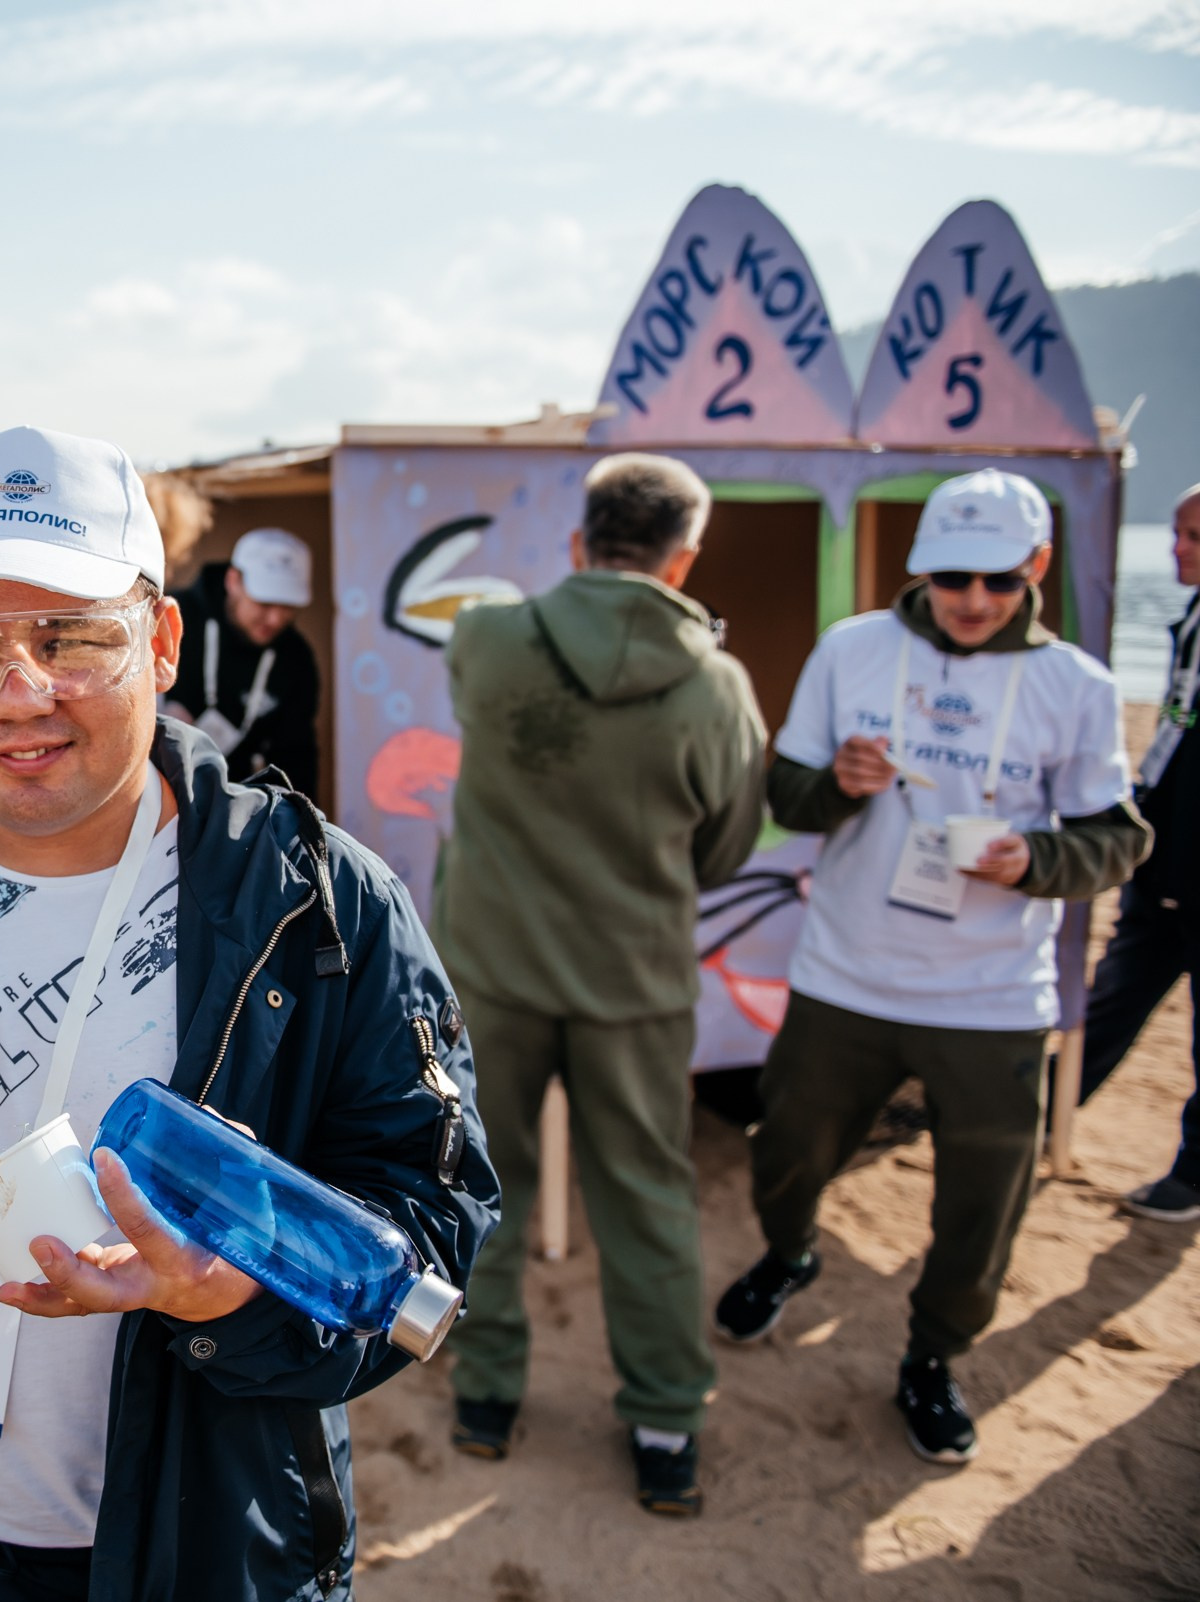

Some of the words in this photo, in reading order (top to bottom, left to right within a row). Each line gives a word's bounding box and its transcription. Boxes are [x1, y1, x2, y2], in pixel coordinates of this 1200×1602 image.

[616, 233, 831, 415] МОРСКОЙ
[705, 334, 754, 420] 2
[945, 352, 983, 429] 5
